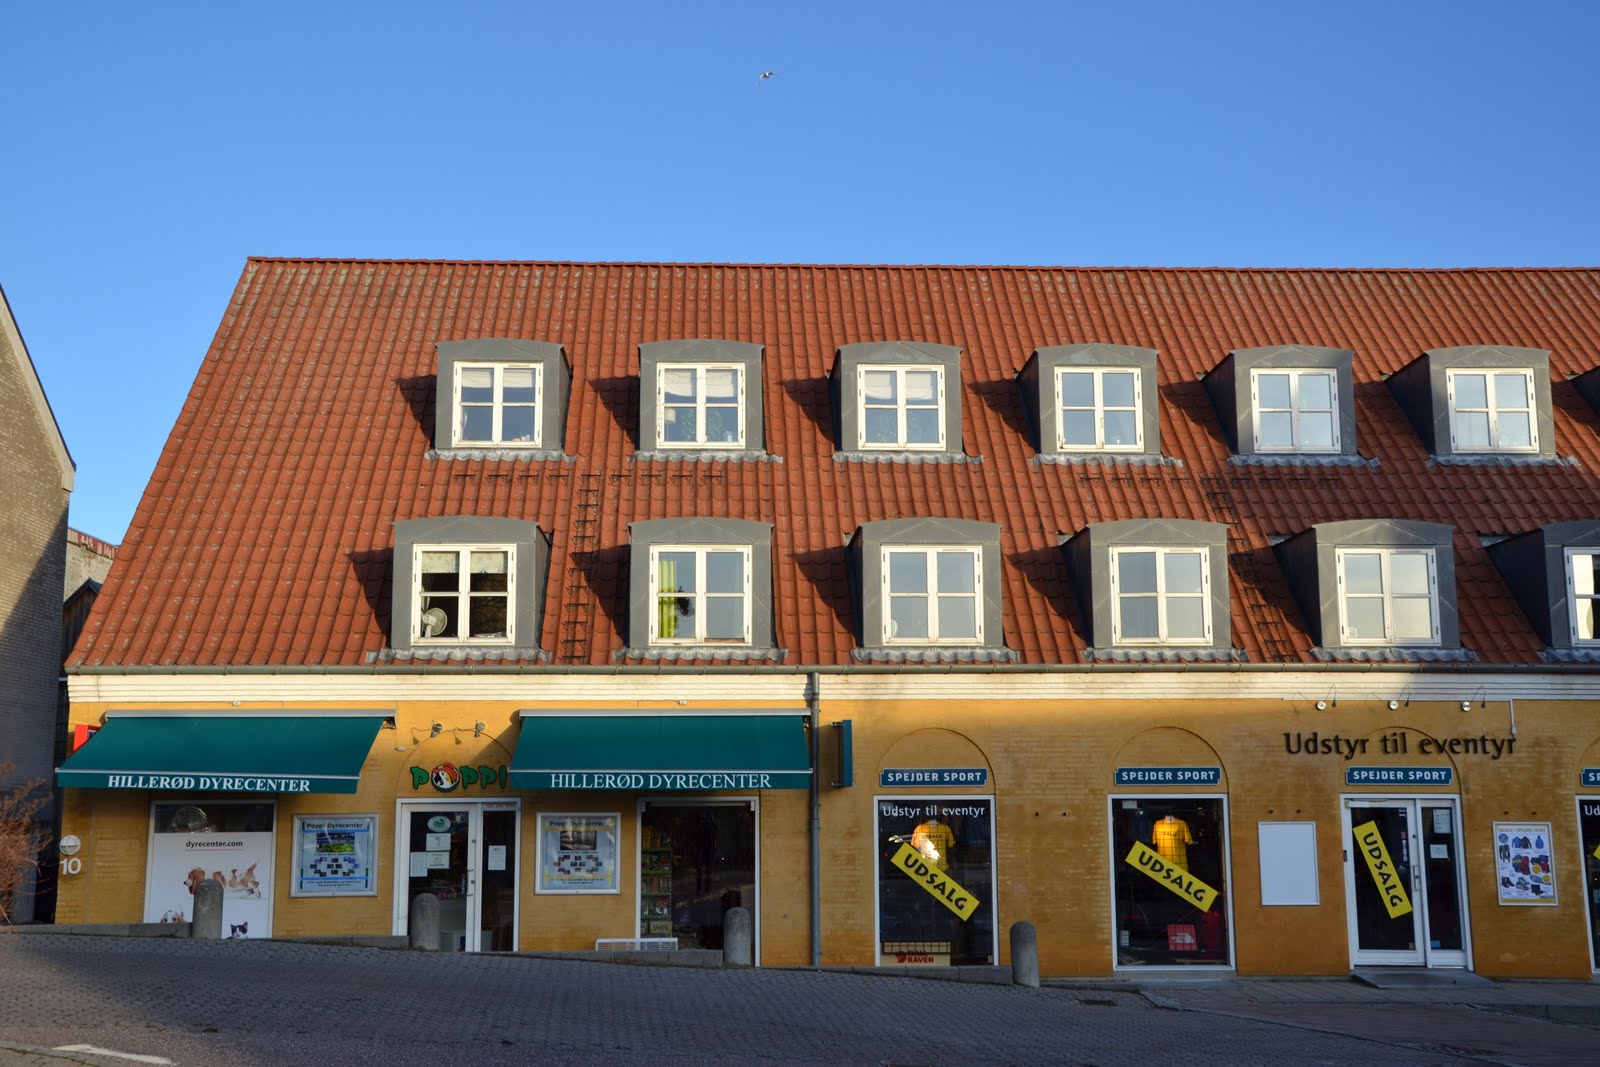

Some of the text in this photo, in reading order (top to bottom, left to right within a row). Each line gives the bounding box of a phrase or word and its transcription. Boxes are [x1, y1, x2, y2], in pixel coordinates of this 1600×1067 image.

[1283, 732, 1517, 760] Udstyr til eventyr
[107, 775, 311, 792] HILLERØD DYRECENTER
[550, 773, 772, 789] HILLERØD DYRECENTER
[887, 772, 982, 782] SPEJDER SPORT
[1121, 771, 1215, 781] SPEJDER SPORT
[1353, 771, 1447, 780] SPEJDER SPORT
[883, 805, 985, 819] Udstyr til eventyr
[185, 841, 243, 849] dyrecenter.com
[59, 857, 82, 875] 10
[1363, 832, 1404, 908] UDSALG
[904, 853, 968, 911] UDSALG
[1138, 851, 1206, 902] UDSALG
[907, 956, 934, 964] RAVEN
